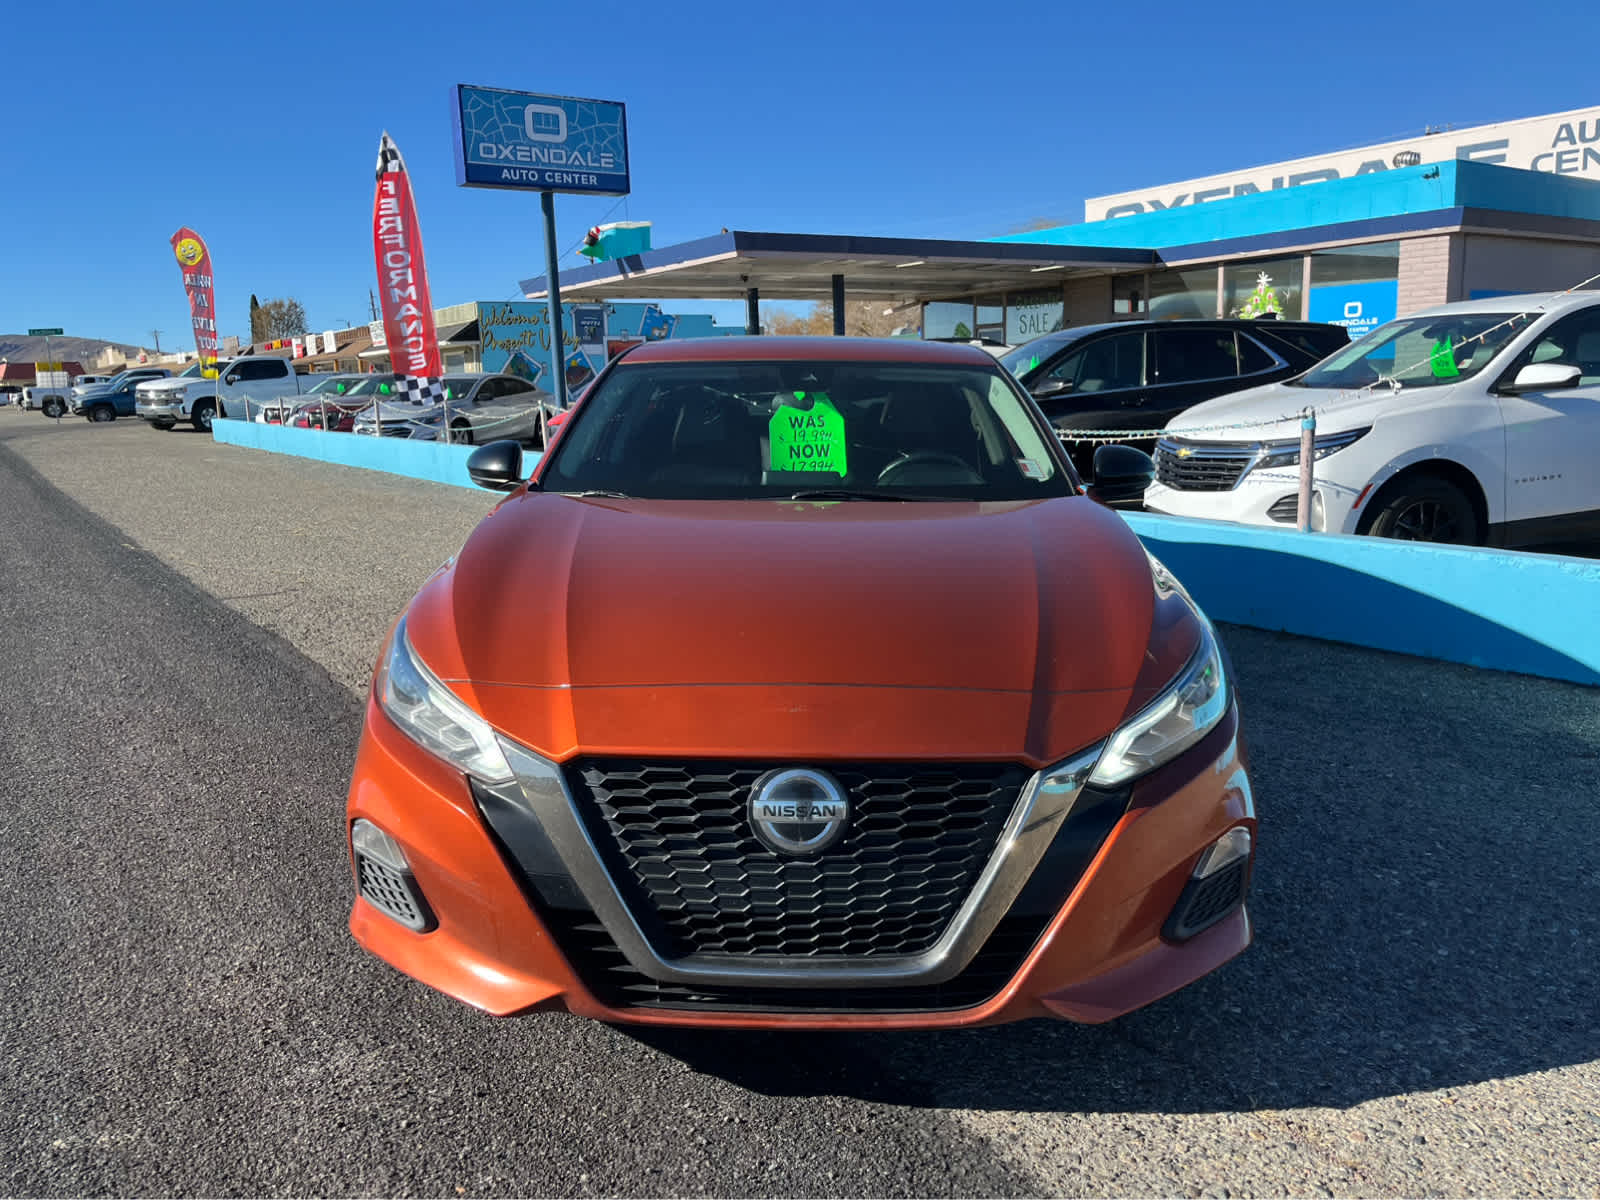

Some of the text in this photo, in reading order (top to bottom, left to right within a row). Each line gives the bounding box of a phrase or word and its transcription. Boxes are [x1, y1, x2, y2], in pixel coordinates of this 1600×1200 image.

[479, 142, 615, 168] OXENDALE
[502, 168, 598, 185] AUTO CENTER
[1019, 312, 1049, 335] SALE
[788, 415, 826, 429] WAS
[789, 444, 831, 459] NOW
[763, 804, 836, 817] NISSAN
